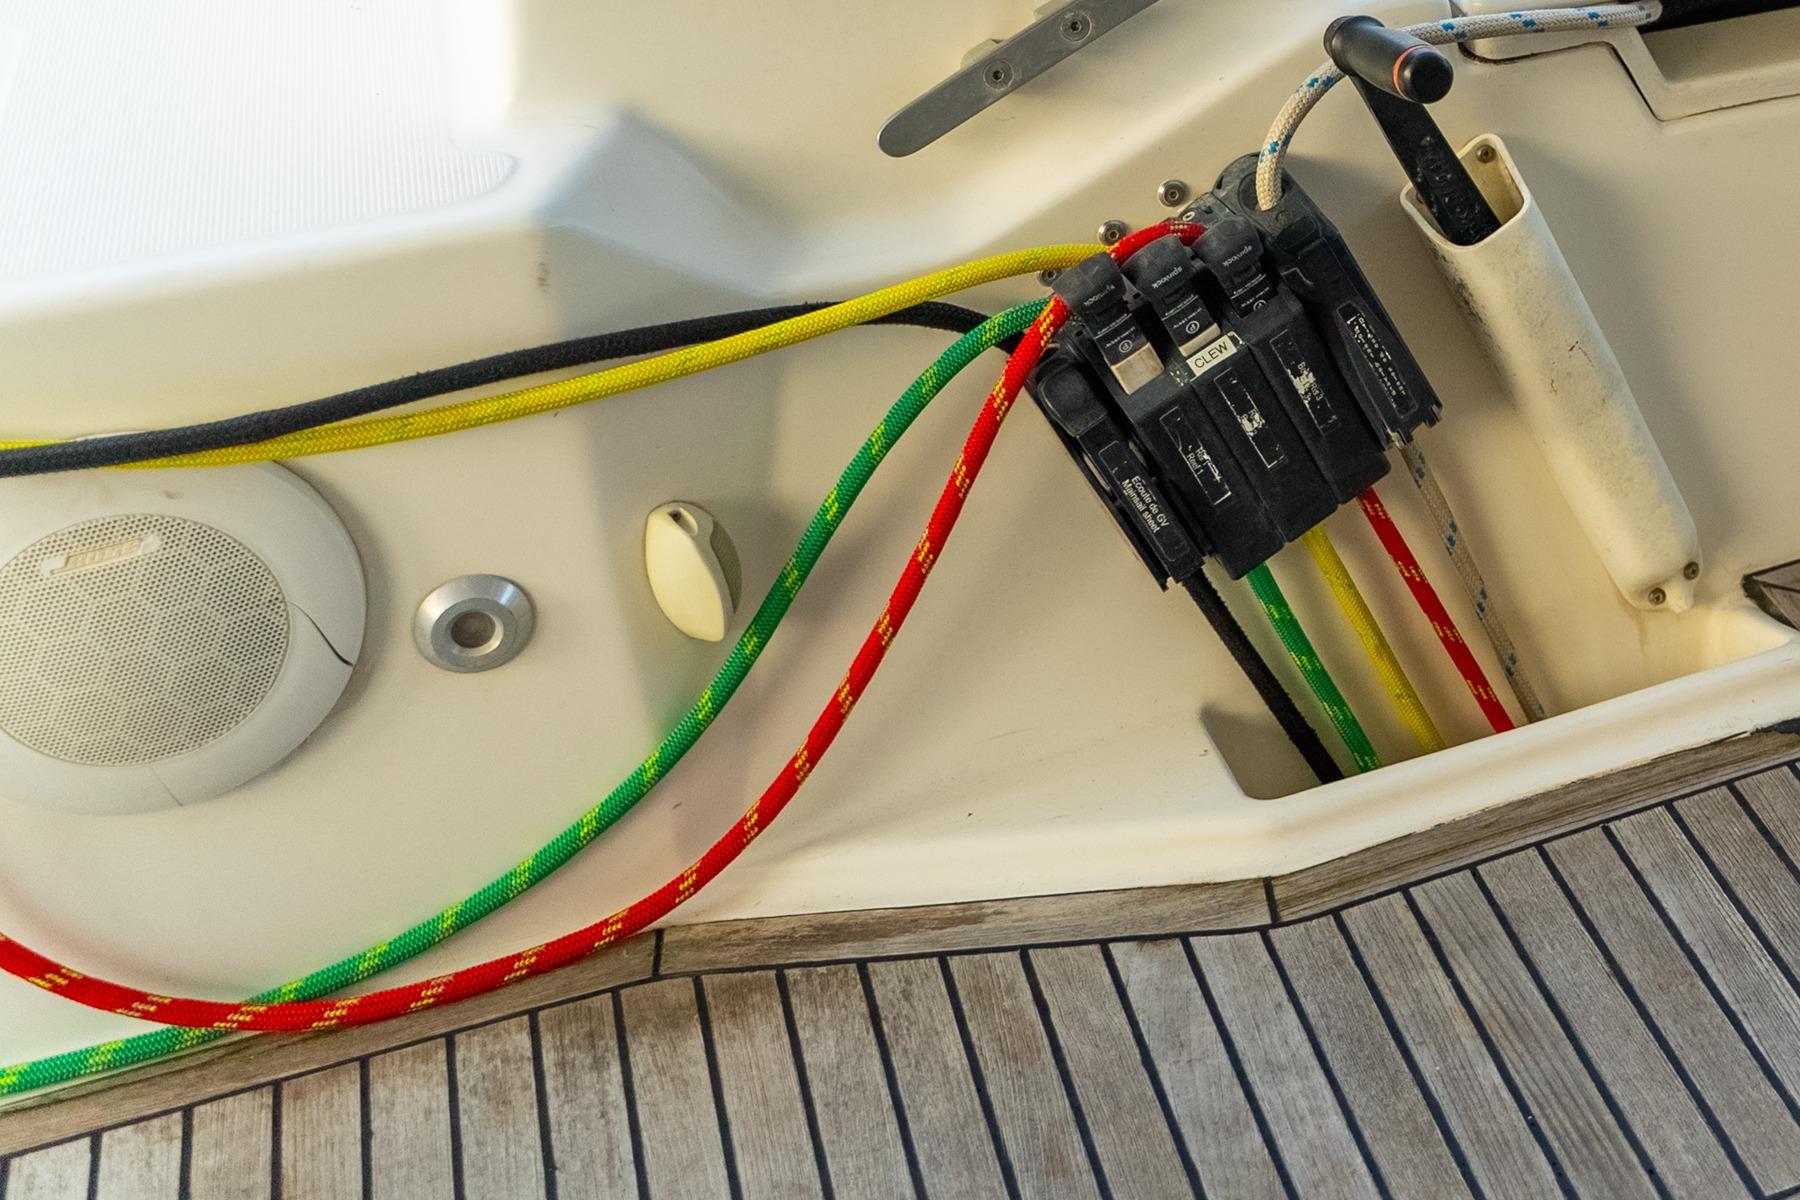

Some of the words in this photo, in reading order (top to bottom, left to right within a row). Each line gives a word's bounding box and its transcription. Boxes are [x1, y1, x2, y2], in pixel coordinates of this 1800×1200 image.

[1222, 245, 1252, 267] spinlock
[1152, 265, 1183, 289] spinlock
[1194, 341, 1228, 368] CLEW
[1120, 478, 1147, 512] Mainsail
[1141, 509, 1161, 534] sheet
[1130, 474, 1154, 504] Ecoute
[1147, 501, 1161, 515] de
[1155, 512, 1170, 528] GV
